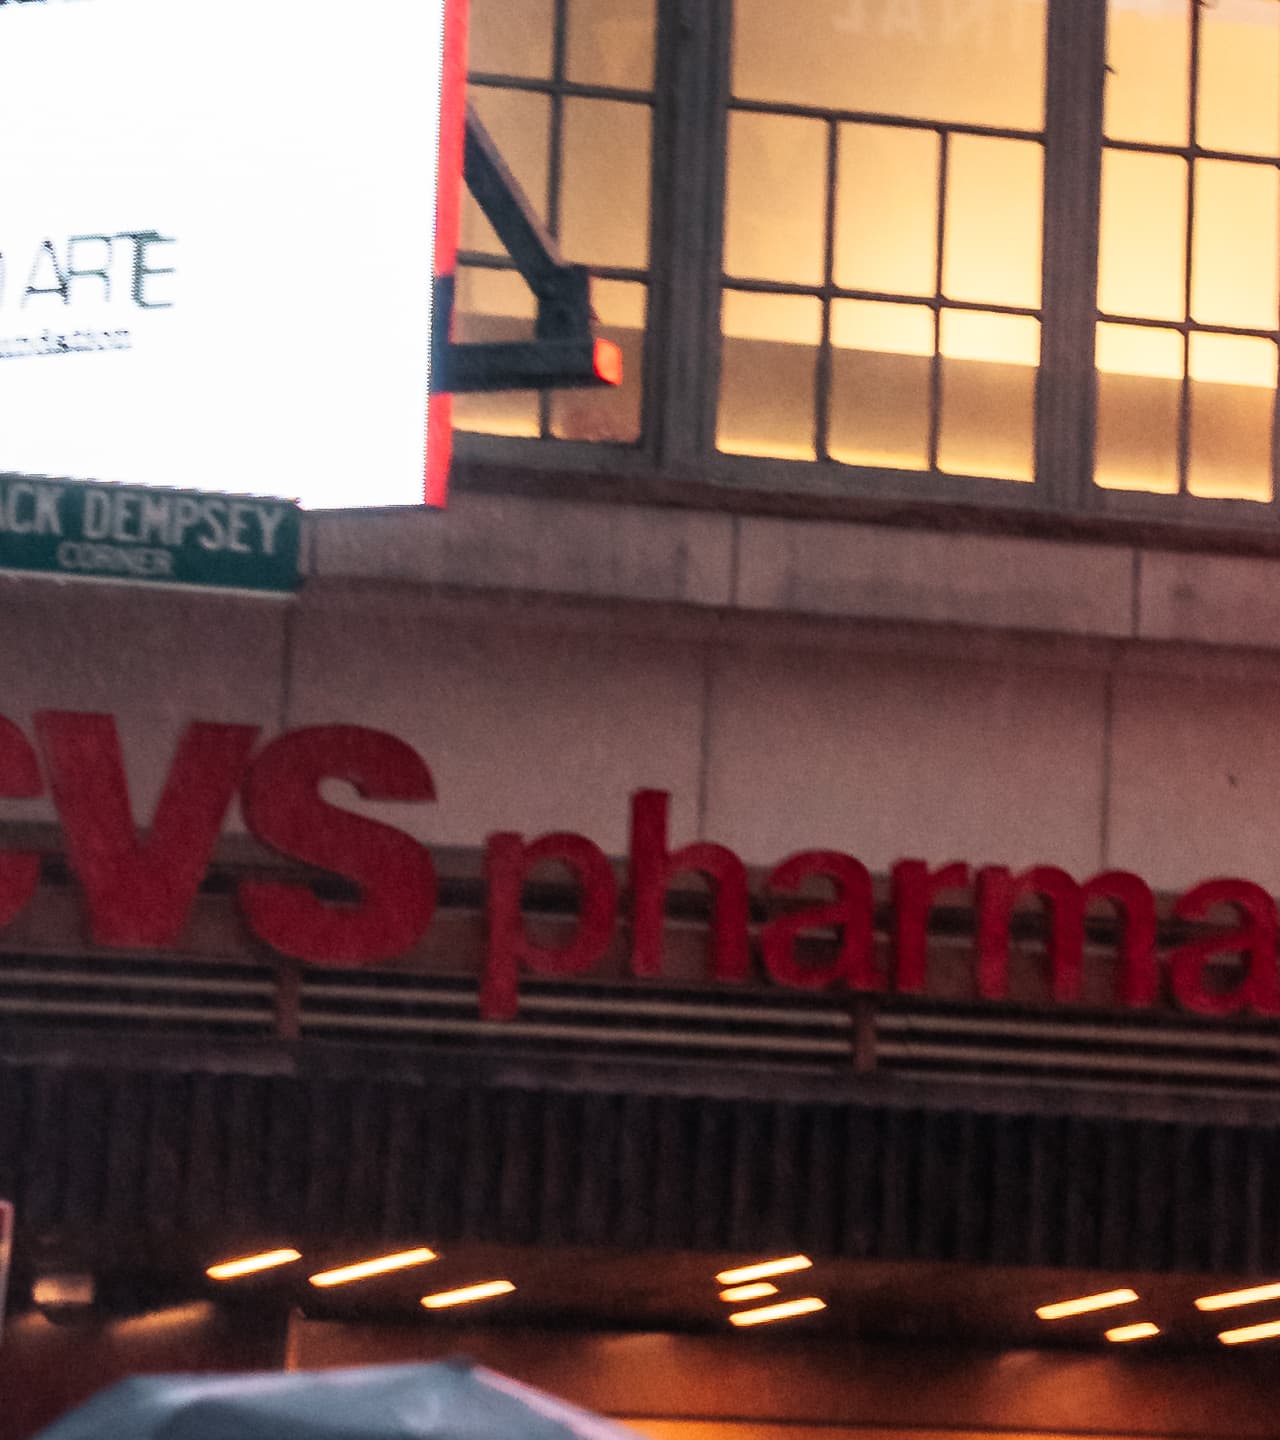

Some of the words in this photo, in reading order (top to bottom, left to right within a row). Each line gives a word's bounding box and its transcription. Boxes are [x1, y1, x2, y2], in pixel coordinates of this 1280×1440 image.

[0, 481, 63, 536] CK
[82, 488, 285, 555] DEMPSEY
[57, 540, 173, 575] CORNER
